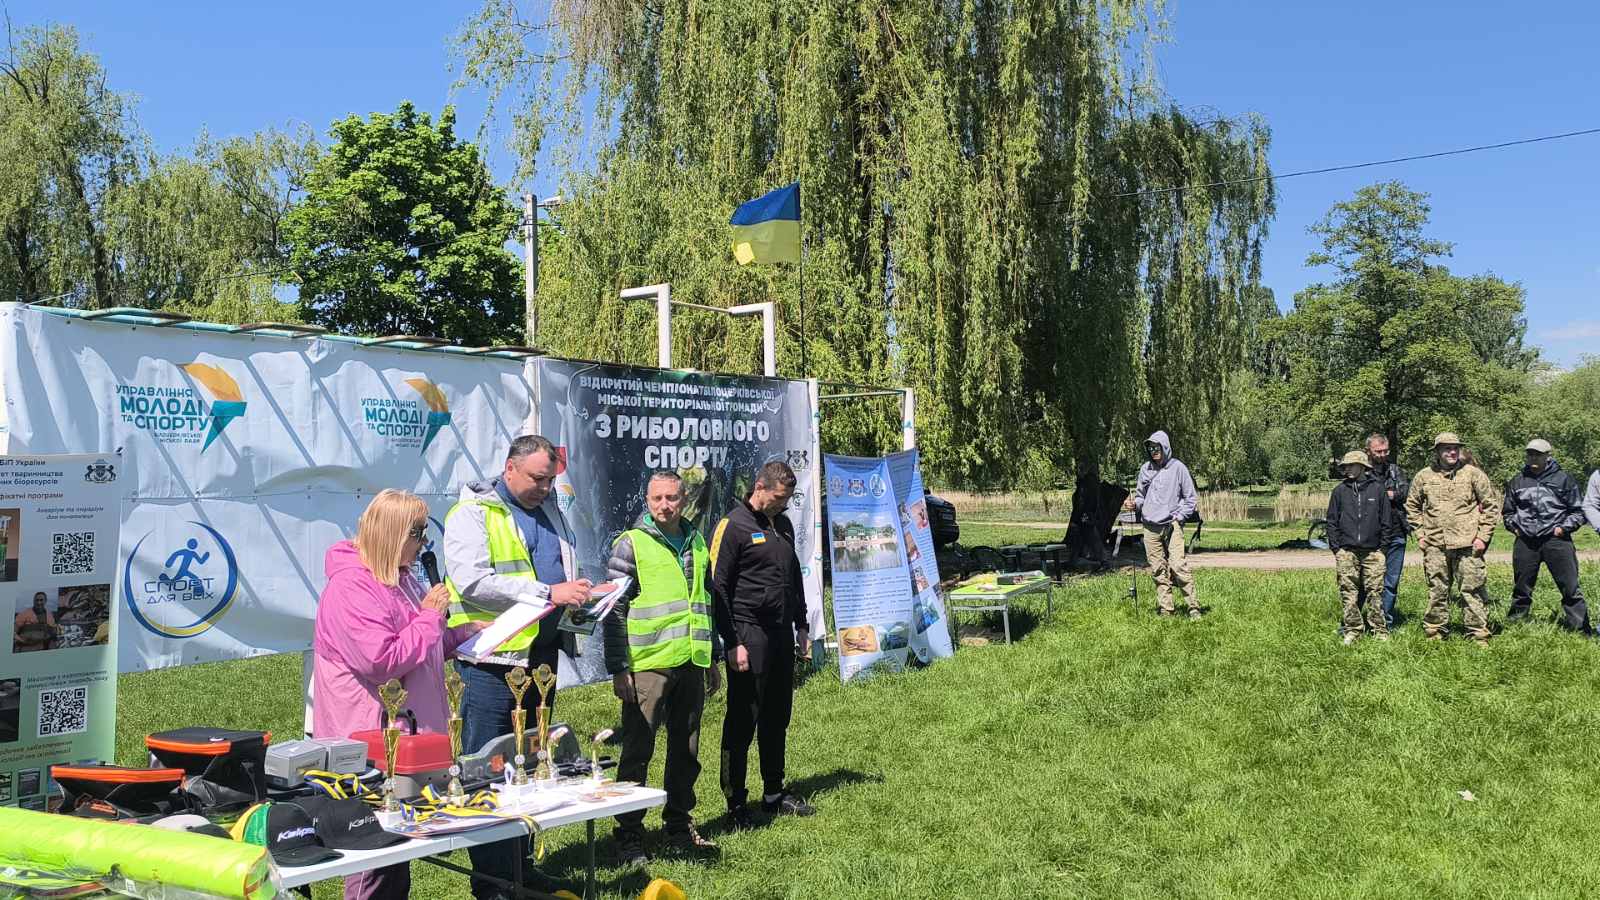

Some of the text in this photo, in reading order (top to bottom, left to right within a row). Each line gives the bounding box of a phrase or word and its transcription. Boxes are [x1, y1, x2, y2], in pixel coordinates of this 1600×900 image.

[115, 384, 193, 398] УПРАВЛІННЯ
[580, 376, 643, 392] ВІДКРИТИЙ
[644, 381, 704, 395] ЧЕМПІОНАТ
[120, 396, 203, 416] МОЛОДІ
[360, 398, 417, 408] УПРАВЛІННЯ
[598, 393, 641, 407] МІСЬКОЇ
[642, 397, 725, 412] ТЕРИТОРІАЛЬНОЇ
[121, 414, 209, 431] ТА СПОРТУ
[365, 407, 422, 424] МОЛОДІ
[376, 423, 426, 437] СПОРТУ
[595, 413, 770, 442] З РИБОЛОВНОГО
[15, 458, 46, 468] України
[644, 445, 728, 469] СПОРТУ
[11, 471, 64, 479] тваринництва
[13, 478, 58, 487] біоресурсів
[144, 577, 215, 593] СПОРТ
[146, 593, 176, 605] ДЛЯ
